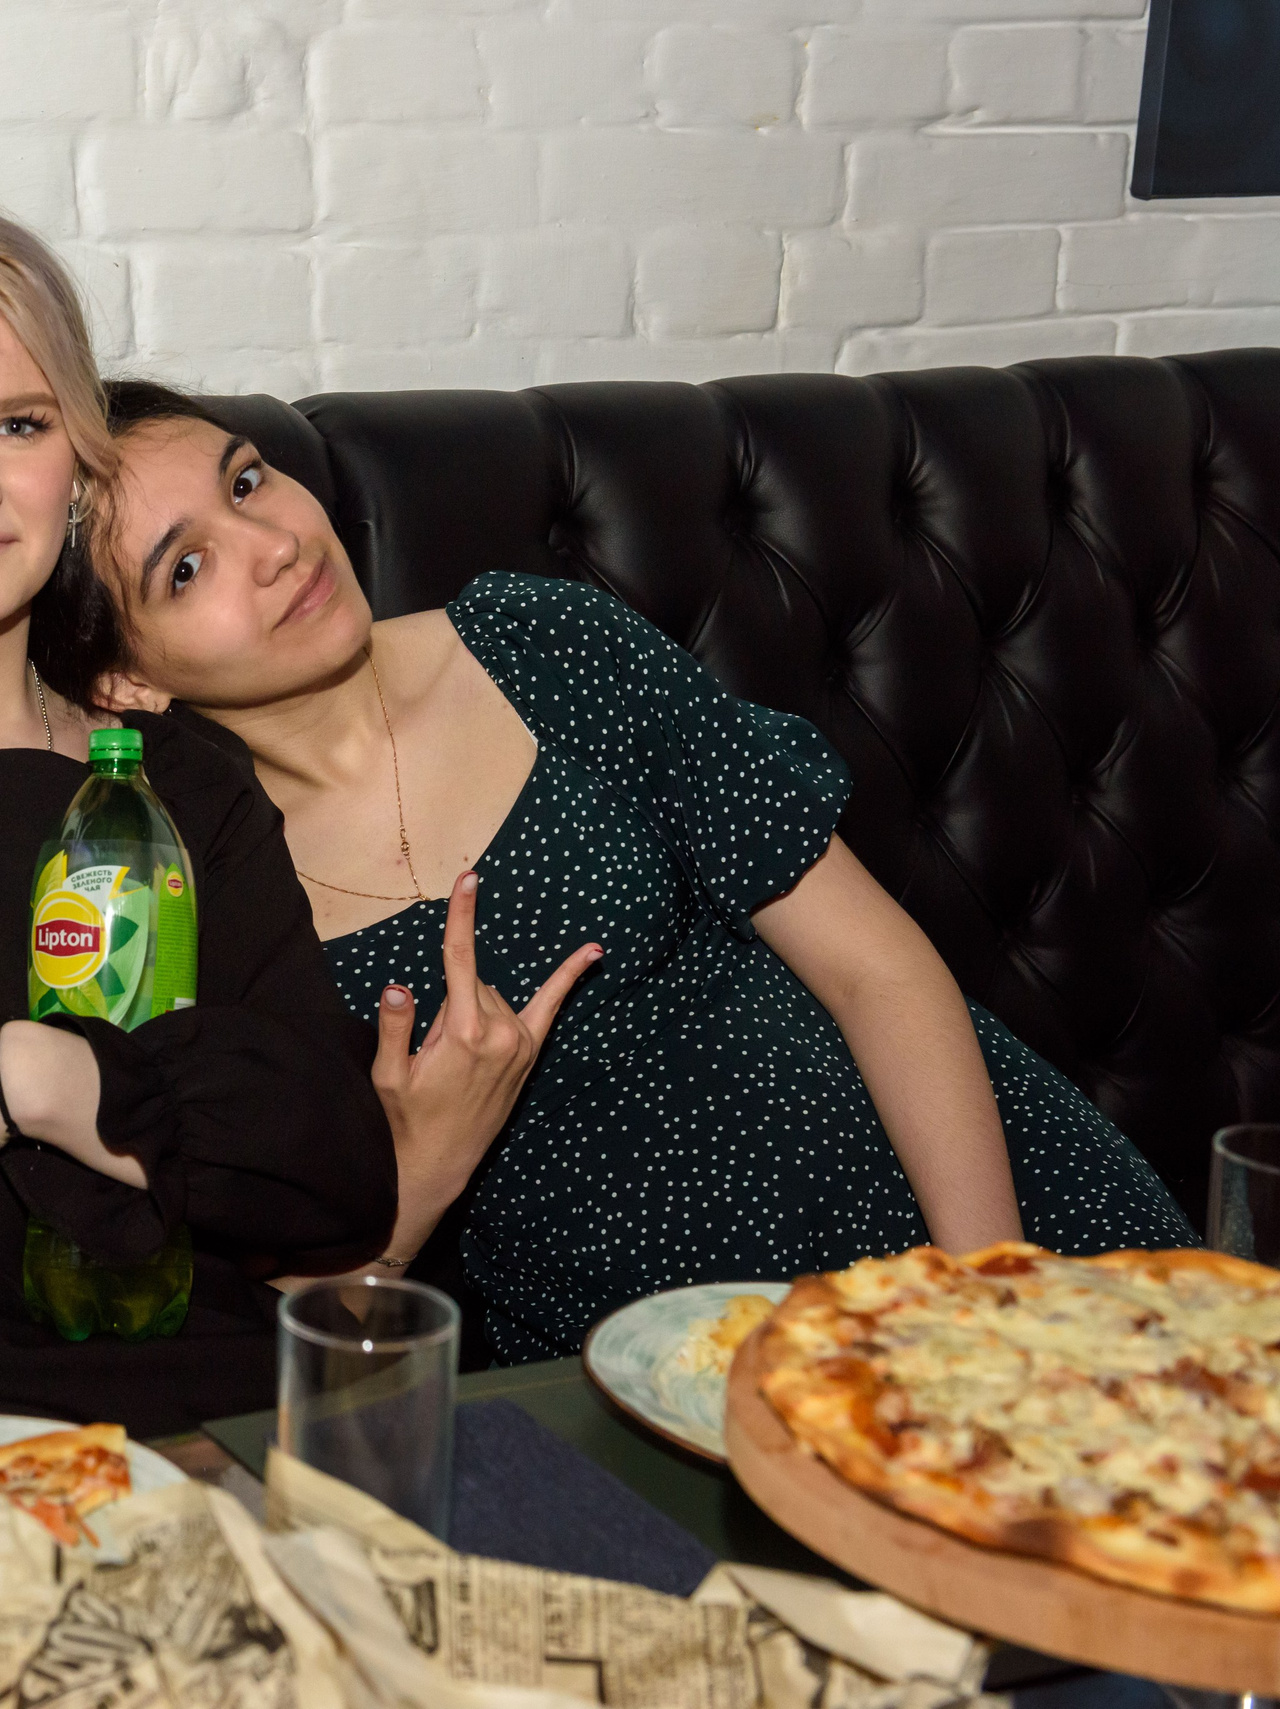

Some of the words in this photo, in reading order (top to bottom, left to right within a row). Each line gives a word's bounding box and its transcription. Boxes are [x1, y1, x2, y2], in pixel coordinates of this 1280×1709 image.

[71, 870, 112, 883] СВЕЖЕСТЬ
[84, 884, 101, 892] ЧАЯ
[38, 928, 93, 950] Lipton
